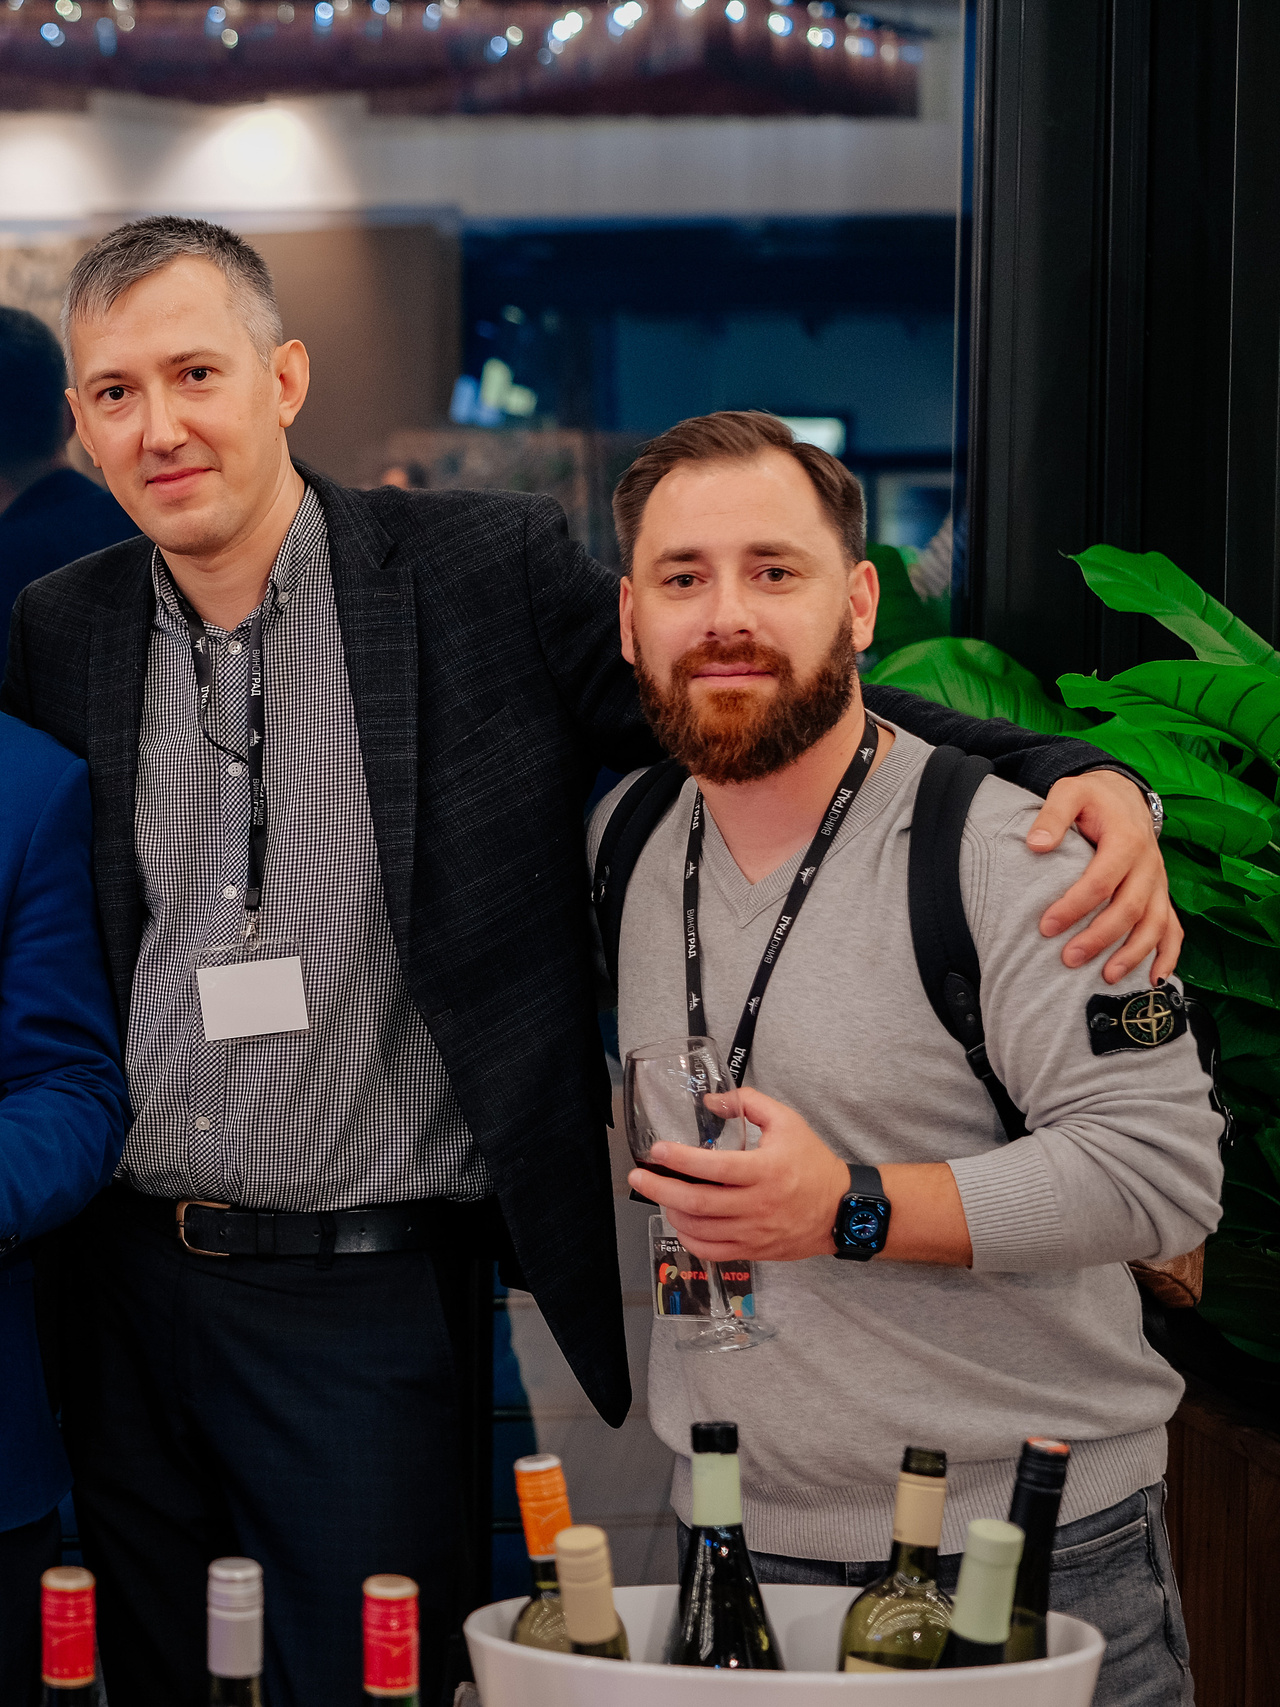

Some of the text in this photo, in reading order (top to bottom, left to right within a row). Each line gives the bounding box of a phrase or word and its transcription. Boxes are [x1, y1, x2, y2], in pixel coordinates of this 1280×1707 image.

[250, 649, 262, 697] ВИНОГРАД
[820, 787, 854, 836] ВИНОГРАД
[686, 908, 697, 959] ВИНОГРАД
[763, 915, 793, 964] ВИНОГРАД
[729, 1046, 747, 1080] ОГРАД
[679, 1270, 751, 1281] ОРГААТОР
